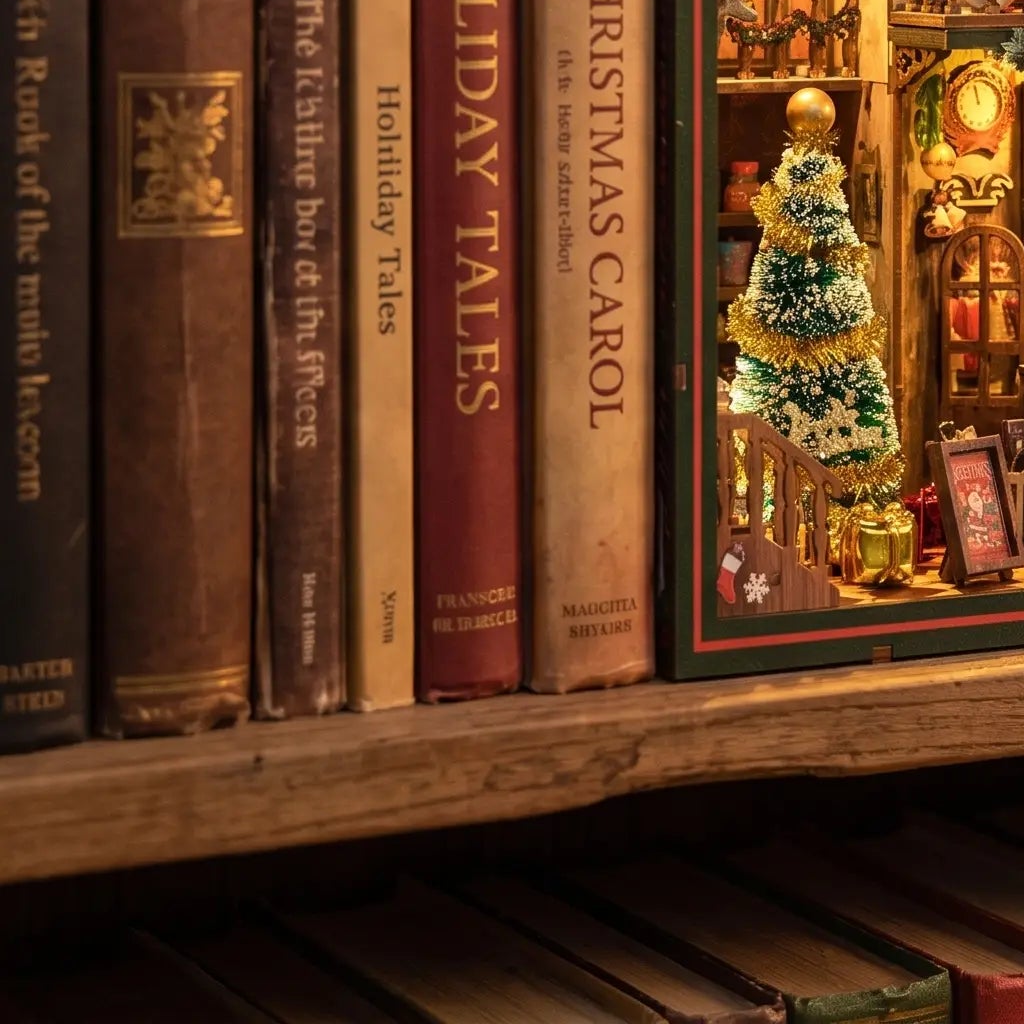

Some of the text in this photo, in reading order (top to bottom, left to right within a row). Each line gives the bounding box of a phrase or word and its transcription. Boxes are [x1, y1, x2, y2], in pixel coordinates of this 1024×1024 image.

[378, 248, 403, 336] Tales
[456, 210, 500, 415] TALES
[588, 251, 625, 430] CAROL
